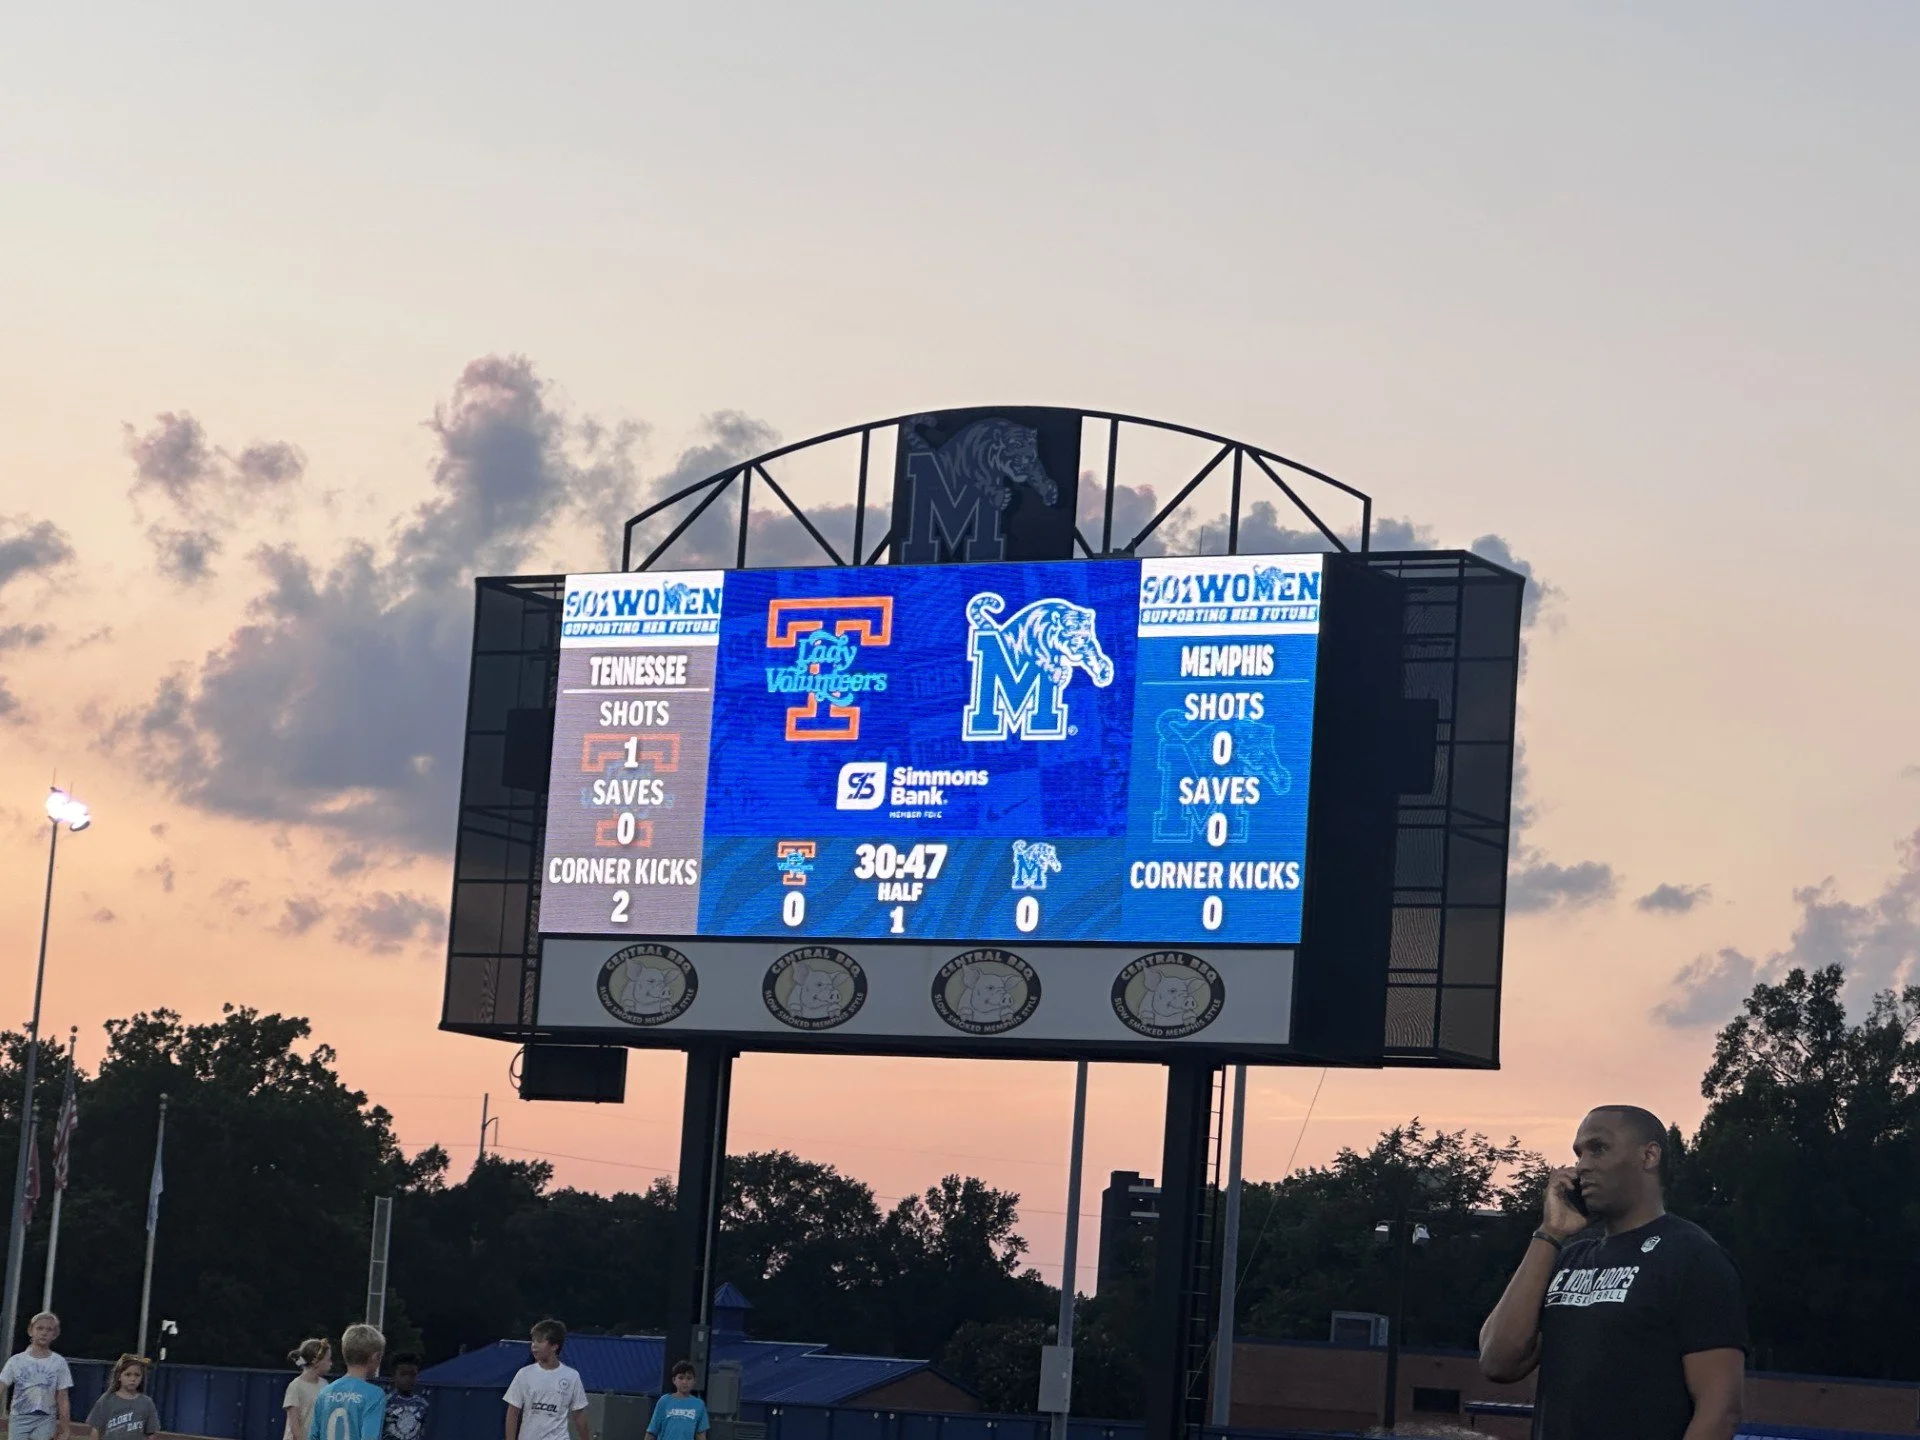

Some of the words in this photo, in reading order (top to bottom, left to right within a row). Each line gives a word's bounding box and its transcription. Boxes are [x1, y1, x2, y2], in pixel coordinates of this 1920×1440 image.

[564, 620, 640, 636] SUPPORTING
[668, 619, 718, 634] FUTURE
[1141, 608, 1228, 623] SUPPORTING
[1230, 607, 1259, 622] HER
[1261, 606, 1317, 621] FUTURE
[796, 630, 858, 671] Lady
[1180, 644, 1274, 677] MEMPHIS
[590, 655, 688, 686] TENNESSEE
[765, 666, 888, 707] Volunteers
[599, 700, 670, 726] SHOTS
[1184, 692, 1264, 721] SHOTS
[623, 736, 639, 768] 1
[1212, 731, 1232, 765] 0
[892, 766, 989, 787] Simmons
[1178, 776, 1260, 805] SAVES
[592, 779, 665, 806] SAVES
[616, 812, 635, 845] 0
[1207, 812, 1227, 847] 0
[549, 857, 630, 884] CORNER
[634, 858, 698, 885] KICKS
[854, 843, 948, 880] 30:47
[1130, 861, 1223, 889] CORNER
[1228, 861, 1300, 889] KICKS
[610, 890, 630, 923] 2
[878, 882, 923, 902] HALF
[782, 890, 805, 926] 0
[889, 906, 905, 933] 1
[1016, 896, 1039, 932] 0
[1202, 896, 1222, 930] 0
[606, 945, 662, 970] CENTRAL
[667, 950, 691, 975] BBQ
[771, 948, 830, 974] CENTRAL
[835, 953, 860, 978] BBQ
[941, 951, 1001, 977] CENTRAL
[1007, 955, 1033, 981] BBQ
[1121, 954, 1184, 980] CENTRAL
[1189, 959, 1217, 984] BBQ
[611, 1007, 643, 1023] SMOKED
[778, 1011, 810, 1028] SMOKED
[947, 1016, 980, 1031] SMOKED
[1128, 1019, 1163, 1036] SMOKED
[1593, 1266, 1640, 1290] HOOPS
